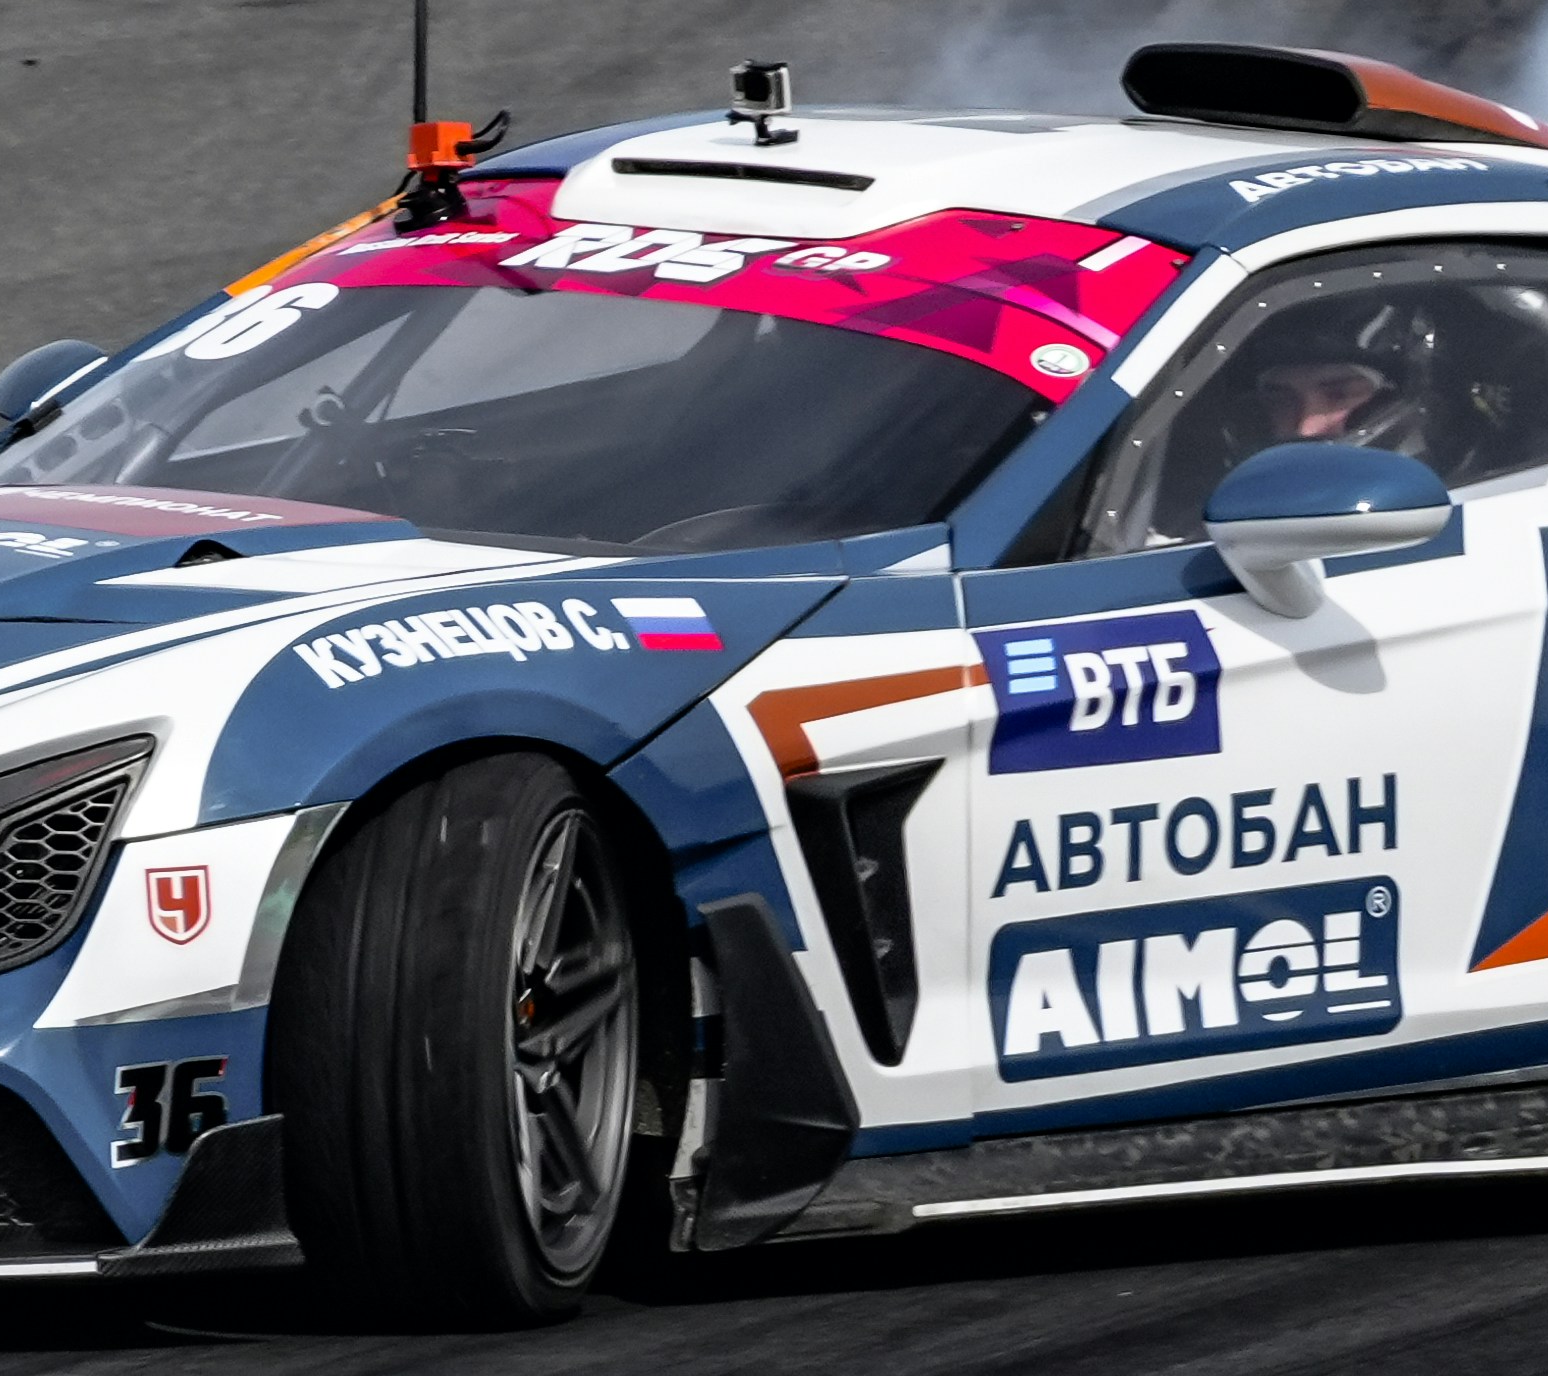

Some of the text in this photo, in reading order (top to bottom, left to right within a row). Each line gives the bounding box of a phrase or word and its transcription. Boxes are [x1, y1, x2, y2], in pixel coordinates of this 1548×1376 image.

[498, 223, 799, 284] RDS
[772, 245, 892, 273] GP
[292, 601, 574, 689] КУЗНЕЦОВ
[1063, 641, 1197, 732] ВТБ
[990, 772, 1398, 899] АВТОБАН
[1003, 910, 1392, 1057] AIMOL
[110, 1054, 229, 1169] 36
